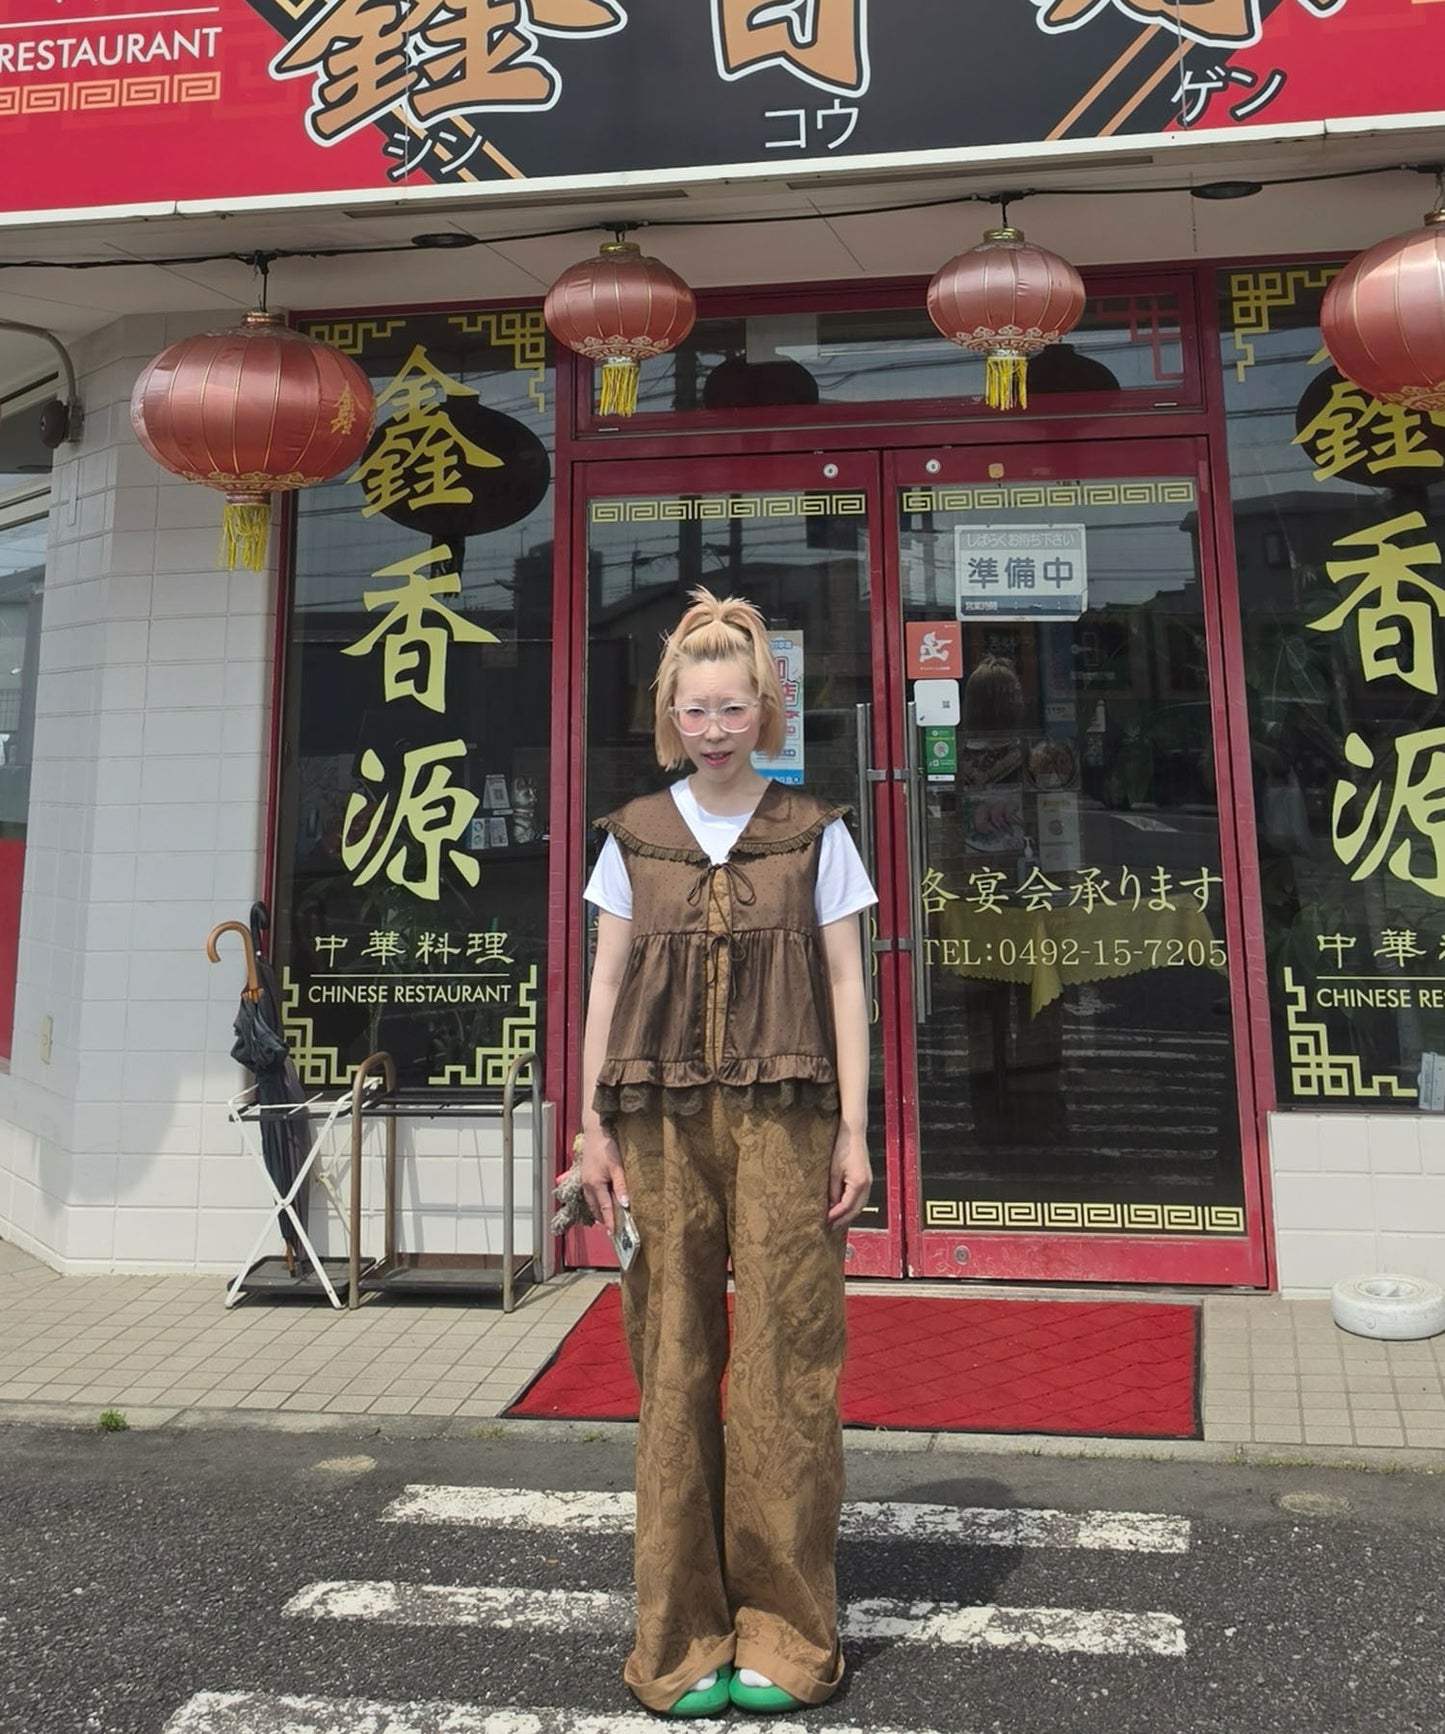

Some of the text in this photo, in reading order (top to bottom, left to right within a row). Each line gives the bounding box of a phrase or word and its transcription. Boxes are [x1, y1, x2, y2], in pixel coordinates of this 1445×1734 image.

[0, 27, 222, 73] RESTAURANT
[1171, 65, 1282, 124] ゲン
[765, 99, 859, 149] コウ
[387, 131, 482, 178] シン
[967, 556, 1074, 590] 準備中
[921, 865, 1224, 915] 各宴会承ります
[314, 929, 515, 968] 中華料理
[923, 938, 1228, 967] TEL:0492-15-7205
[1316, 929, 1445, 968] 中華
[308, 984, 512, 1003] CHINESE RESTAURANT
[1316, 988, 1445, 1008] CHINESE RE
